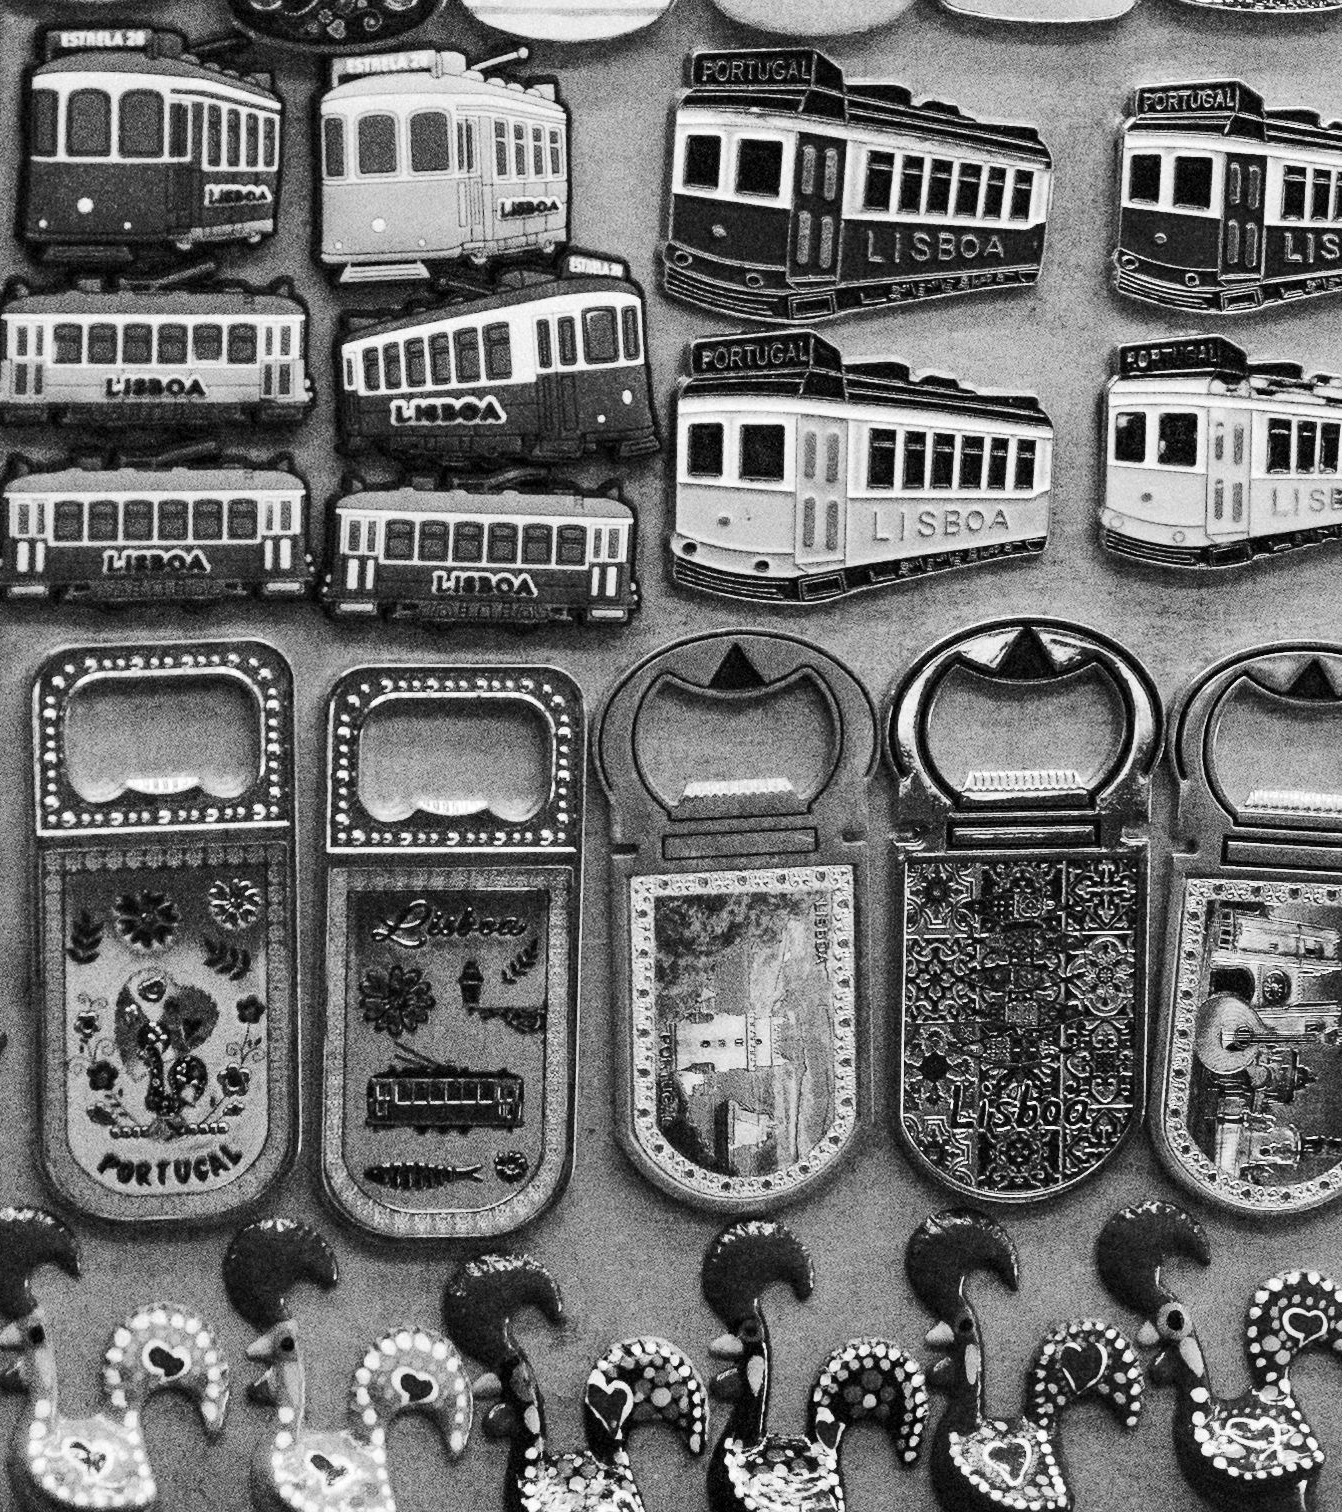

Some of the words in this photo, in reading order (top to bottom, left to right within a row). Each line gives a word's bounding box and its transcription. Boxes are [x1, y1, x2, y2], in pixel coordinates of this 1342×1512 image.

[701, 59, 812, 83] PORTUGAL
[1143, 87, 1237, 112] PORTUGAL
[207, 188, 273, 206] LISBOA
[499, 200, 562, 218] LISBOA
[866, 228, 1004, 262] LISBOA
[701, 339, 810, 370] PORTUGAL
[105, 375, 210, 399] LISBOA
[391, 397, 507, 426] LISBOA
[871, 509, 1011, 542] LISBOA
[103, 550, 211, 575] LISBOA
[432, 573, 539, 597] LISBOA
[371, 899, 528, 948] Lisboa
[951, 1084, 1094, 1129] Lisboa
[97, 1143, 244, 1187] PORTUGAL
